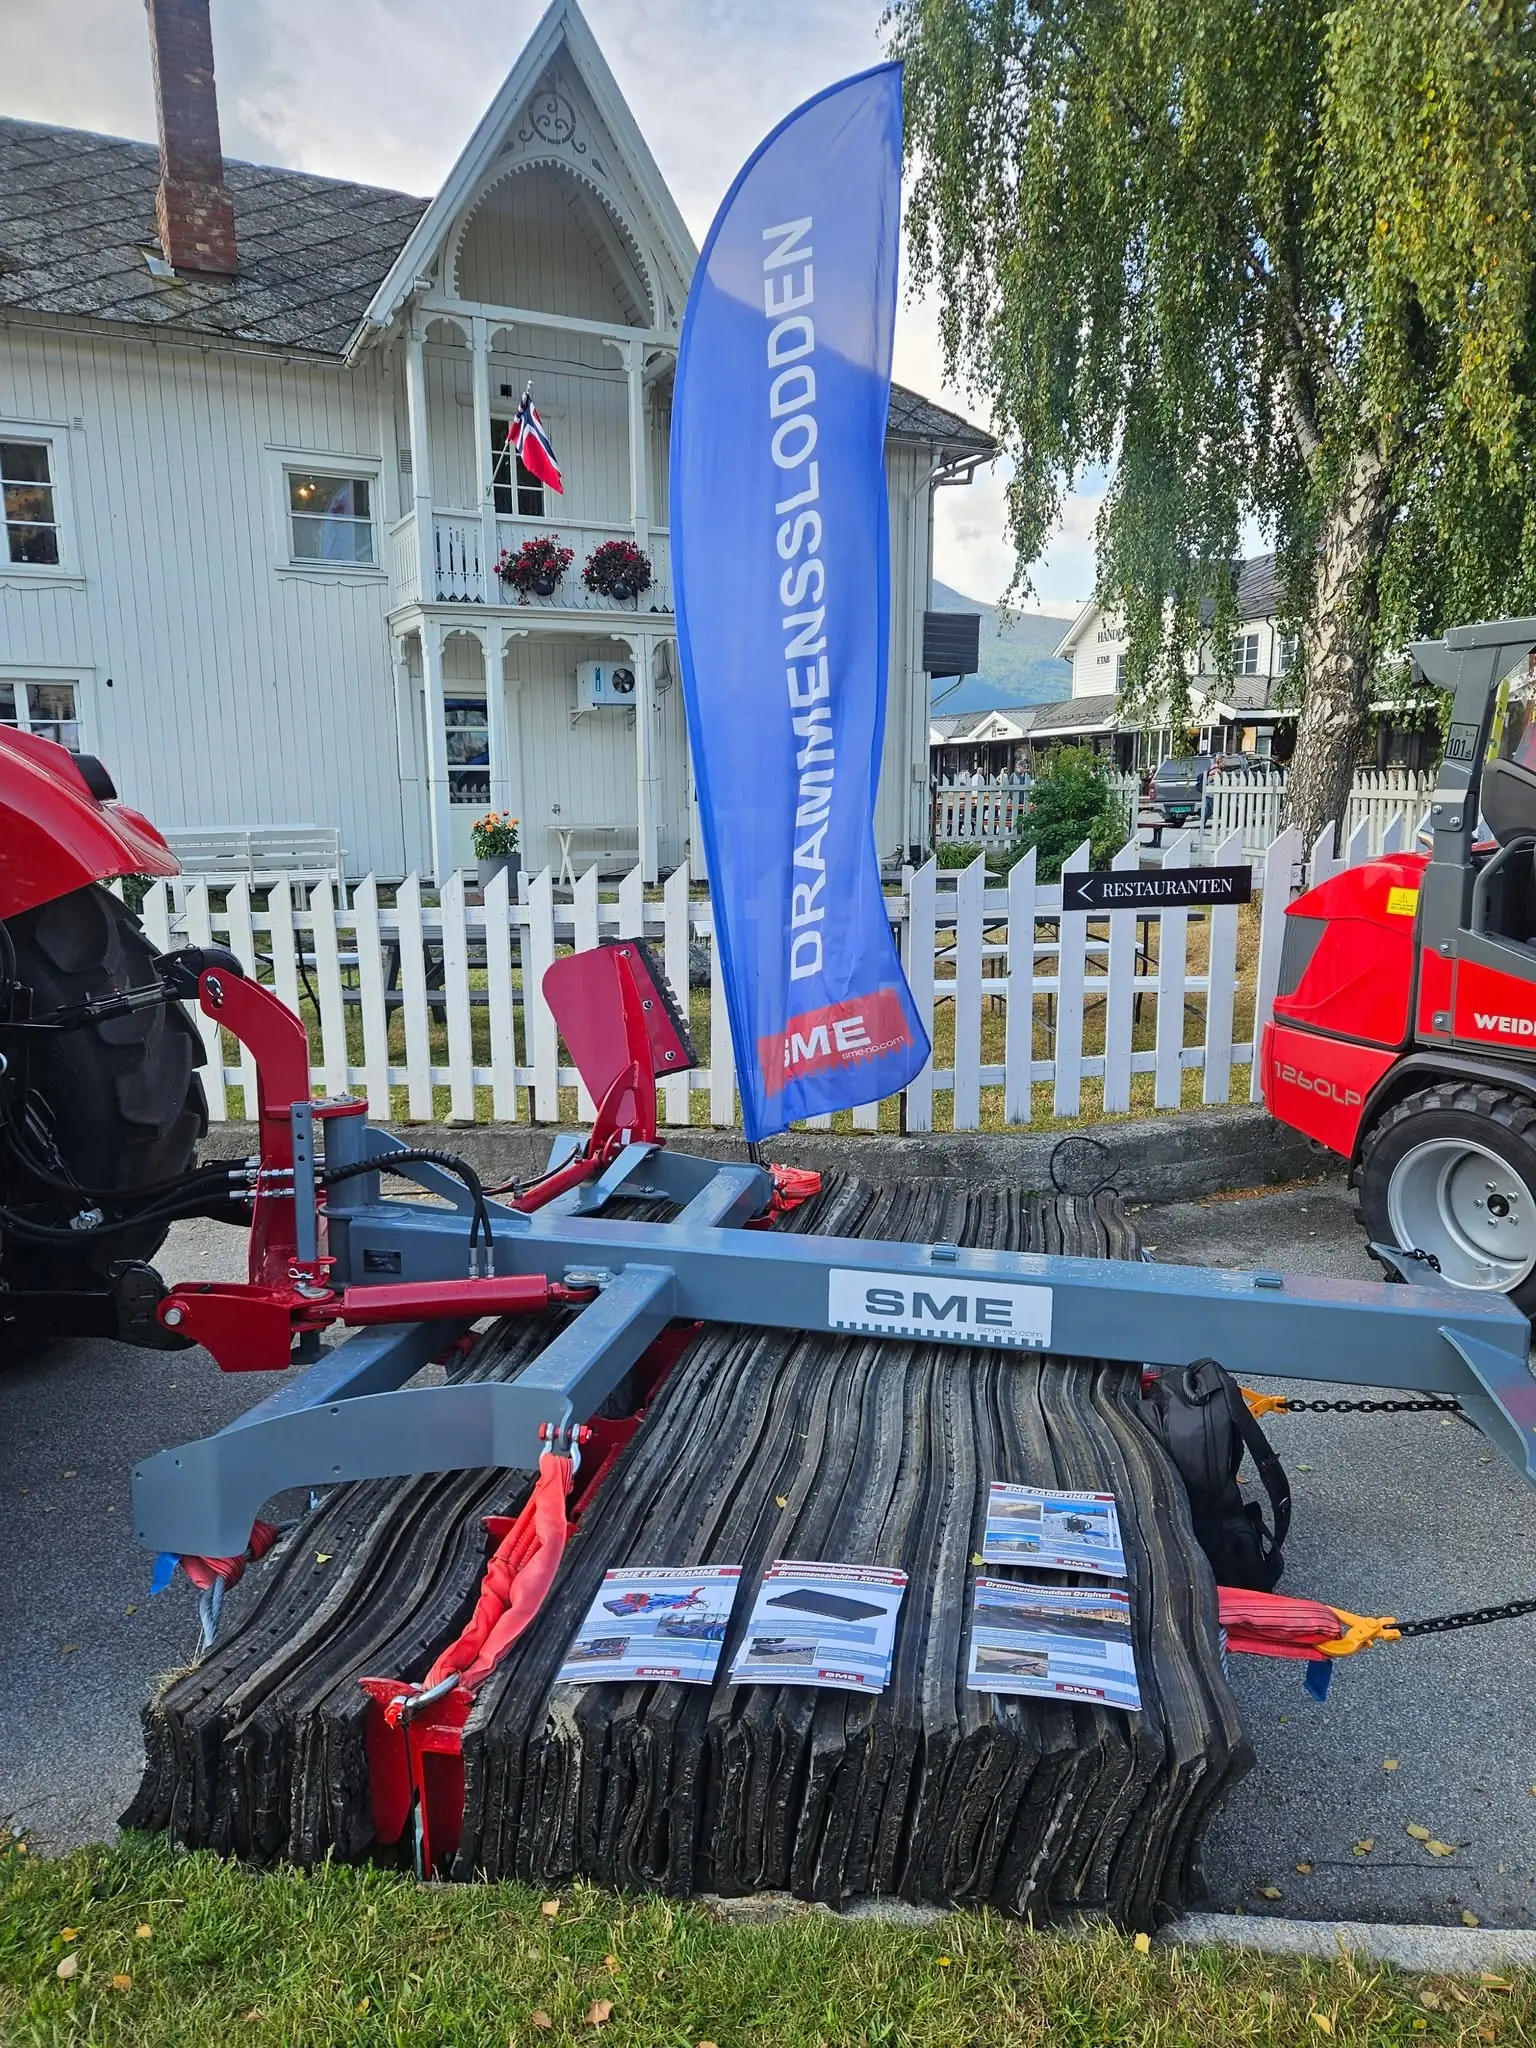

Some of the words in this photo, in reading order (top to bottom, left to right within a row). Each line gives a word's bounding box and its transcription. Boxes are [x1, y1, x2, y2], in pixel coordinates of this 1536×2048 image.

[762, 216, 835, 982] DRAMMENSSLODDEN
[1449, 738, 1466, 757] 101
[1102, 878, 1233, 898] RESTAURANTEN
[1473, 1012, 1536, 1037] WEID
[841, 1034, 905, 1060] sme-no.com
[1274, 1060, 1362, 1106] 1260LP
[865, 1288, 1013, 1328] SME
[976, 1326, 1044, 1339] sme-no.com
[615, 1571, 641, 1580] SME
